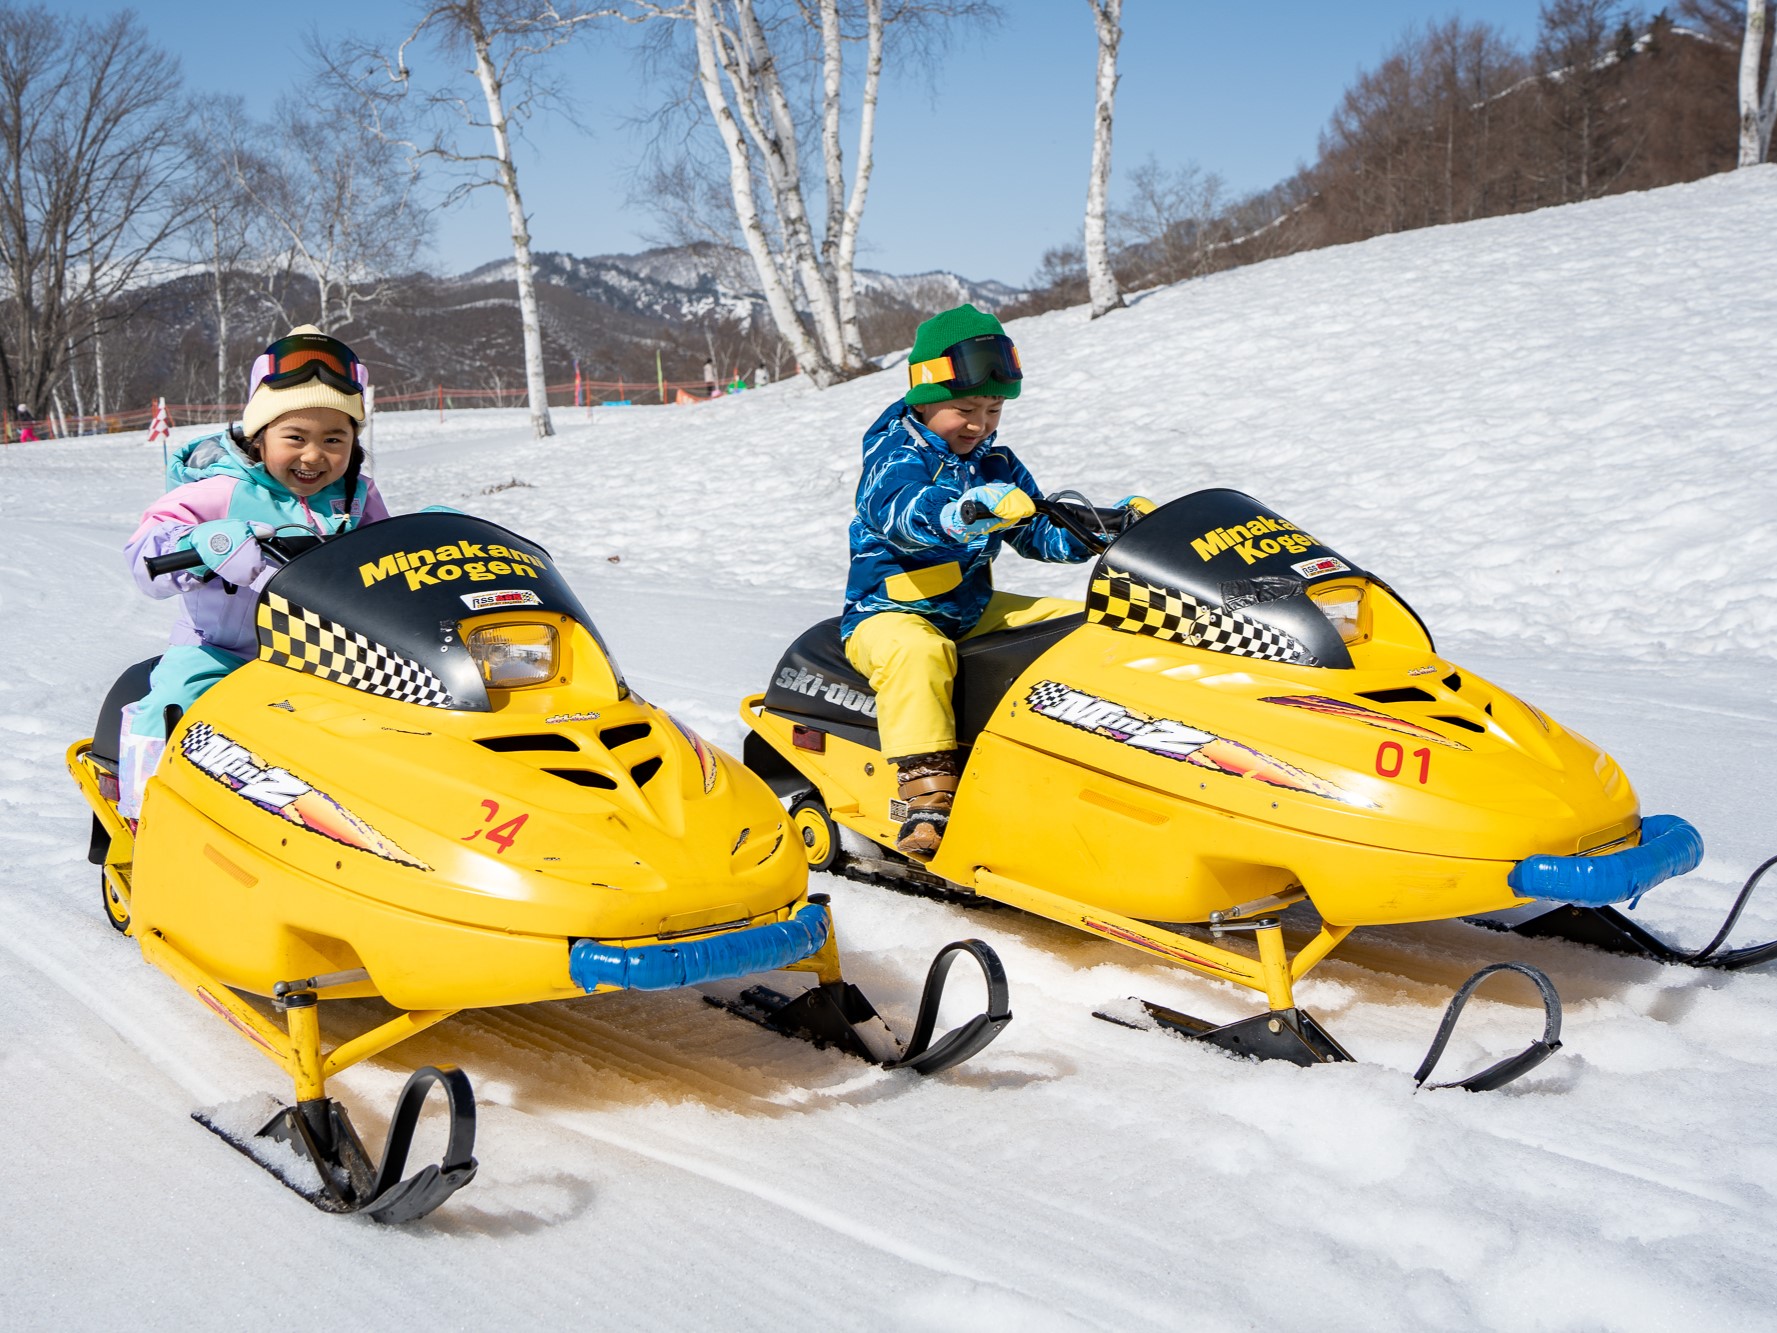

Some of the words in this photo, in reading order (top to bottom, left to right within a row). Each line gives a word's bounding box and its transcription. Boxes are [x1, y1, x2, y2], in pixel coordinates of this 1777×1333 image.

[1190, 516, 1302, 562] Minaka
[359, 541, 547, 588] Minakami
[405, 561, 539, 591] Kogen
[1376, 741, 1431, 784] 01
